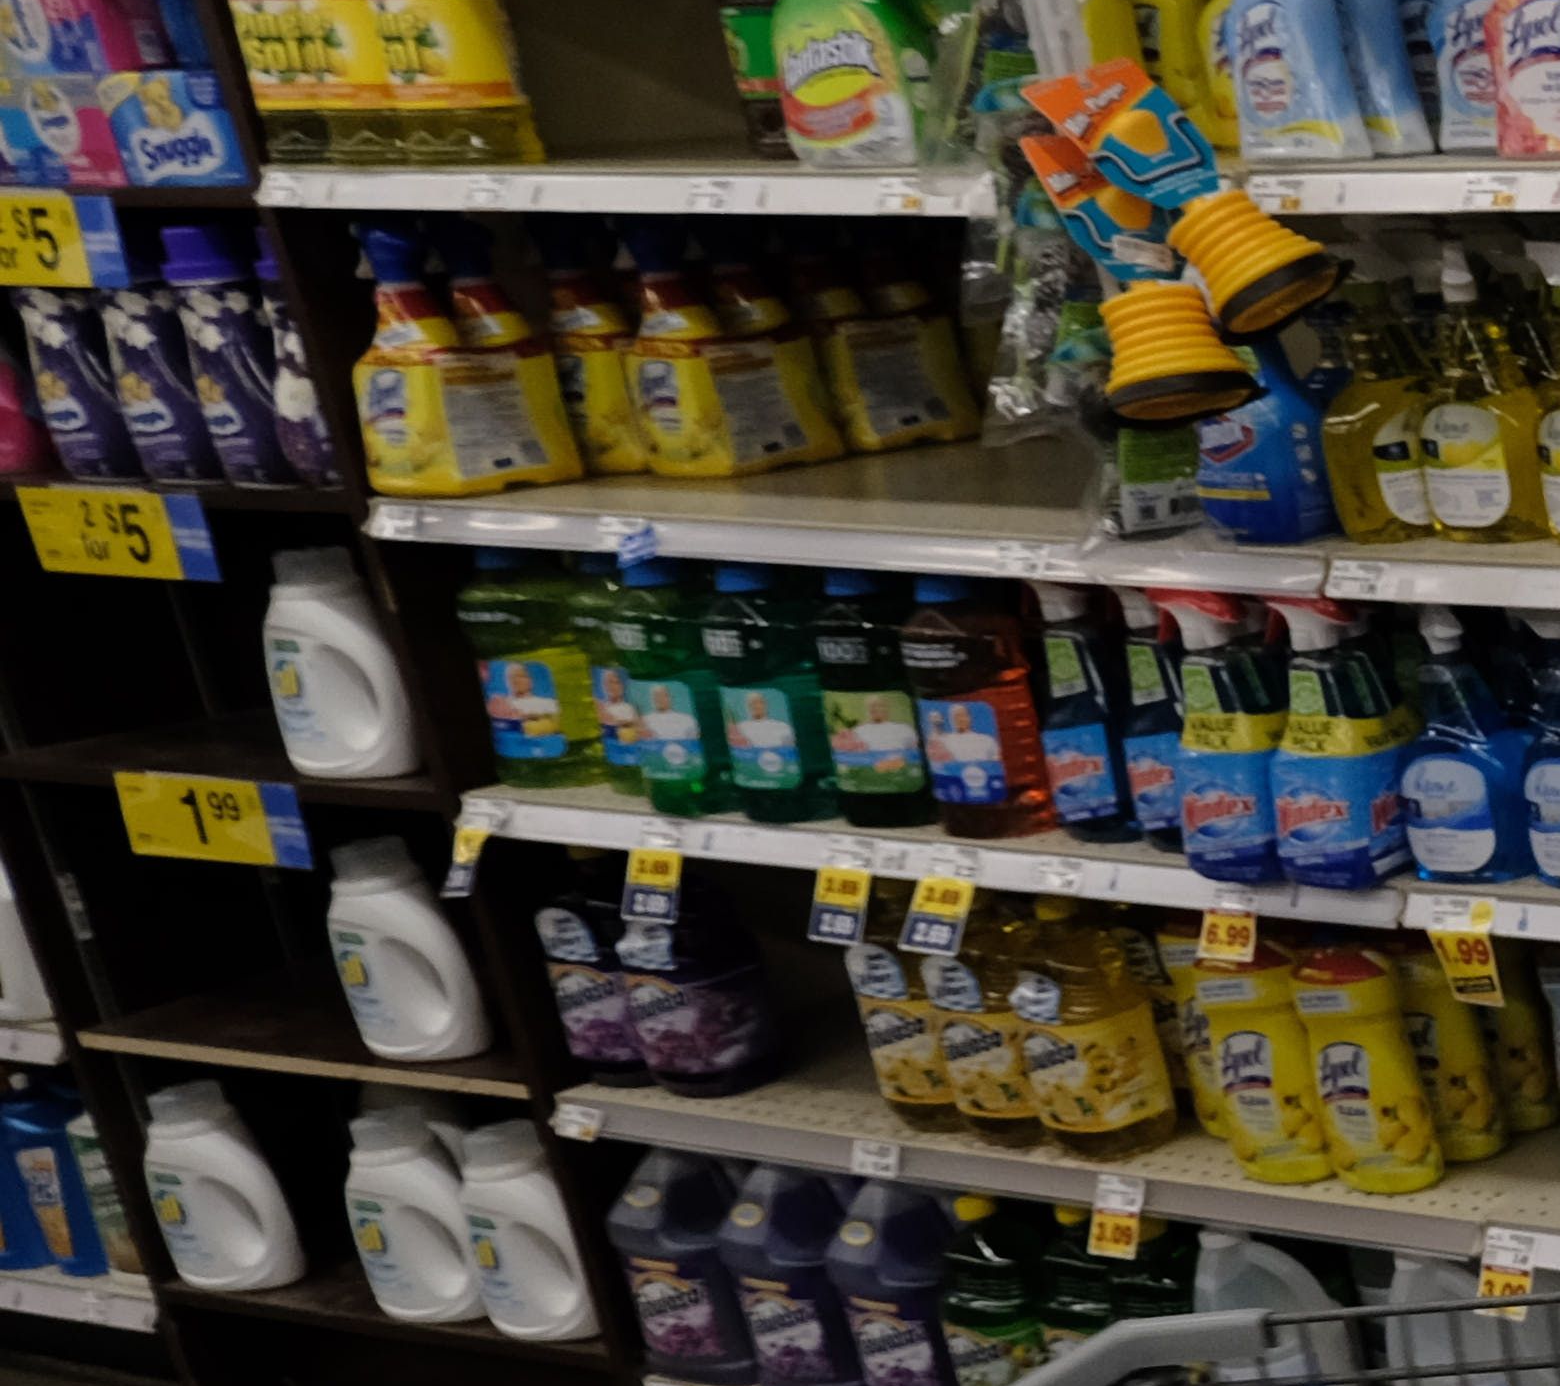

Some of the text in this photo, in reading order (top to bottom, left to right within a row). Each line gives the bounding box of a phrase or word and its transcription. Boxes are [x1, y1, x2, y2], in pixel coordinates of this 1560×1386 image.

[106, 496, 151, 564] $5
[180, 788, 211, 846] 1
[1206, 923, 1250, 948] 6.99
[1438, 937, 1491, 966] 1.99
